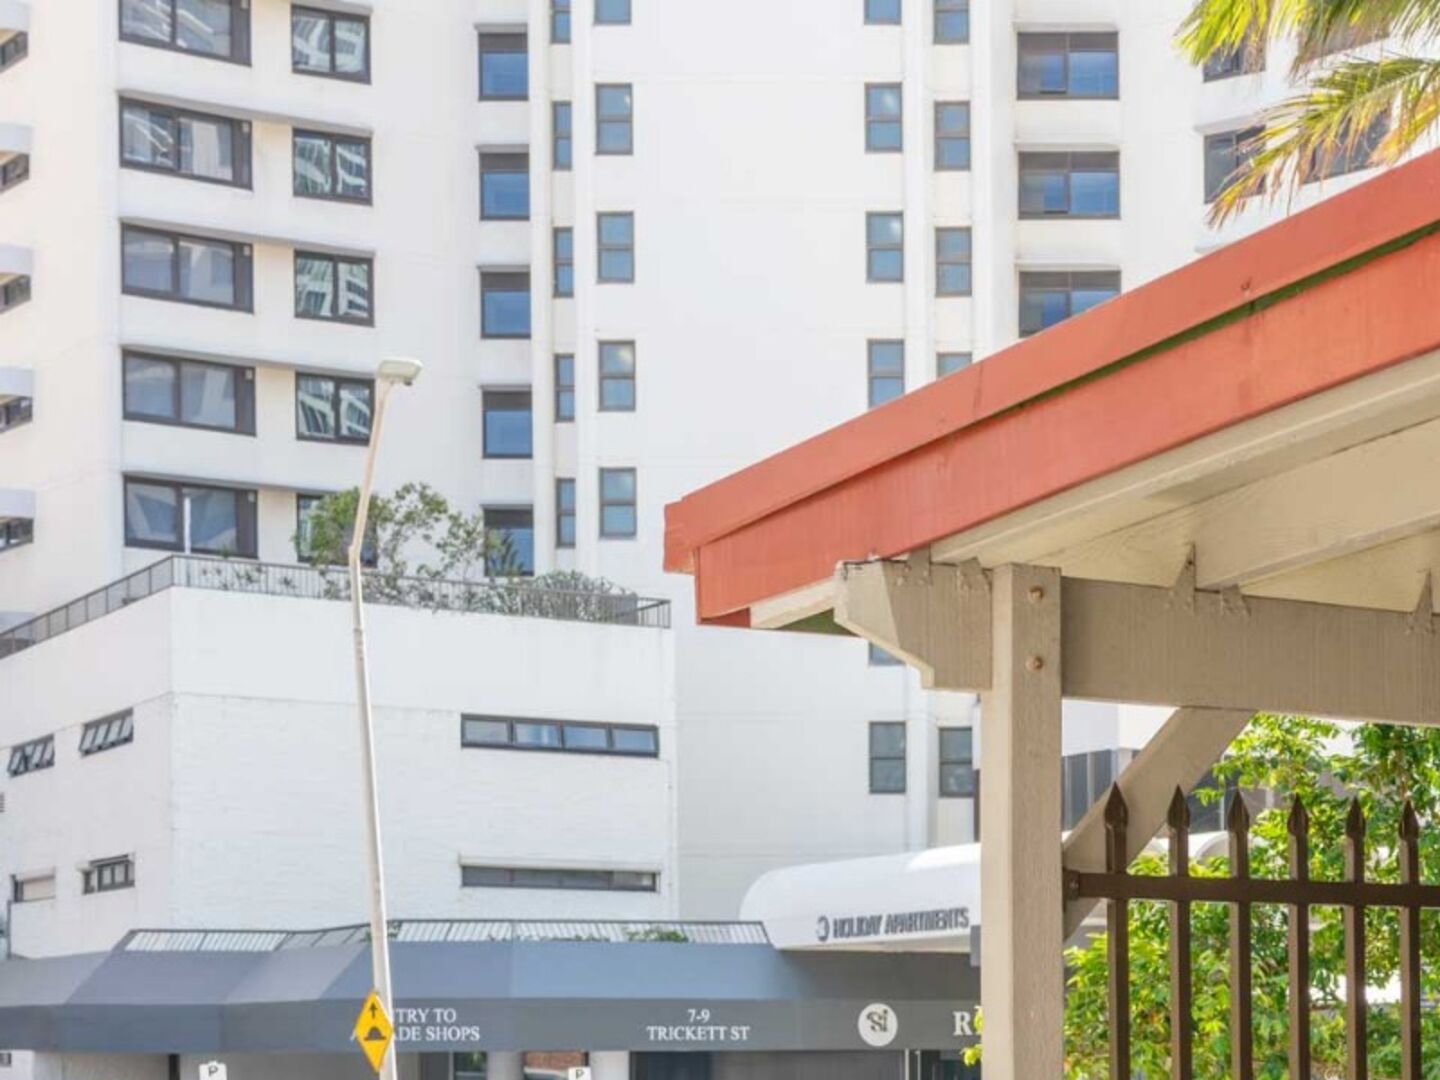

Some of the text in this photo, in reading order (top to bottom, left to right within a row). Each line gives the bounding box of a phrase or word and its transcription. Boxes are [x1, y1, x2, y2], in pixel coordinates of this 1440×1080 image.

[833, 907, 970, 938] HOLIDAY APARTMENTS
[392, 1007, 457, 1023] TRY TO
[687, 1008, 711, 1023] 7-9
[425, 1026, 480, 1042] SHOPS
[646, 1025, 750, 1041] TRICKETT ST
